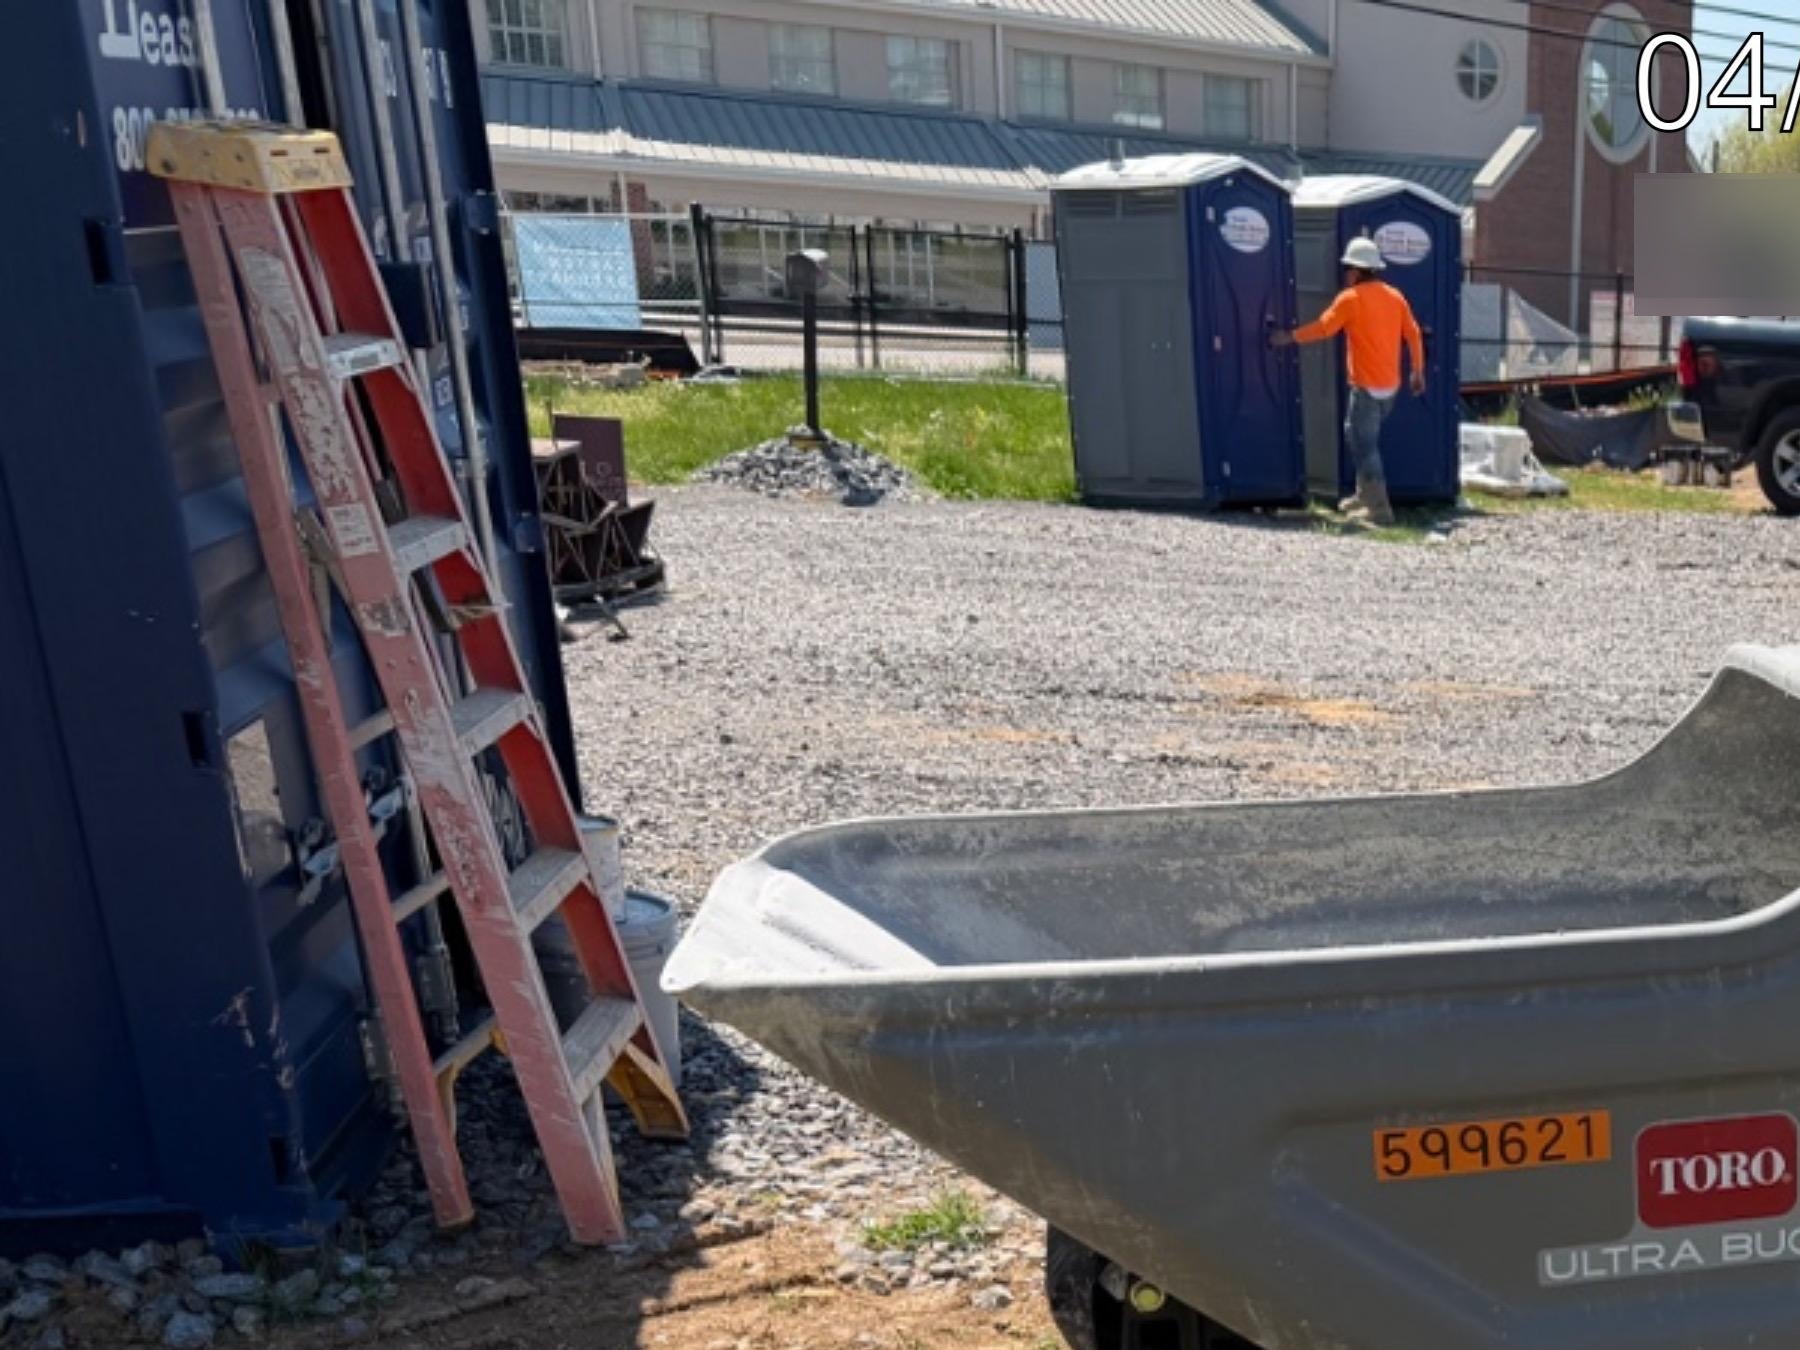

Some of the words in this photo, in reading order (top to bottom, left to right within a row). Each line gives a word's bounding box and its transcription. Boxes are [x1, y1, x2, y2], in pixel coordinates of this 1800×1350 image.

[1383, 1116, 1595, 1177] 599621
[1649, 1148, 1787, 1195] TORO
[1544, 1238, 1705, 1281] ULTRA
